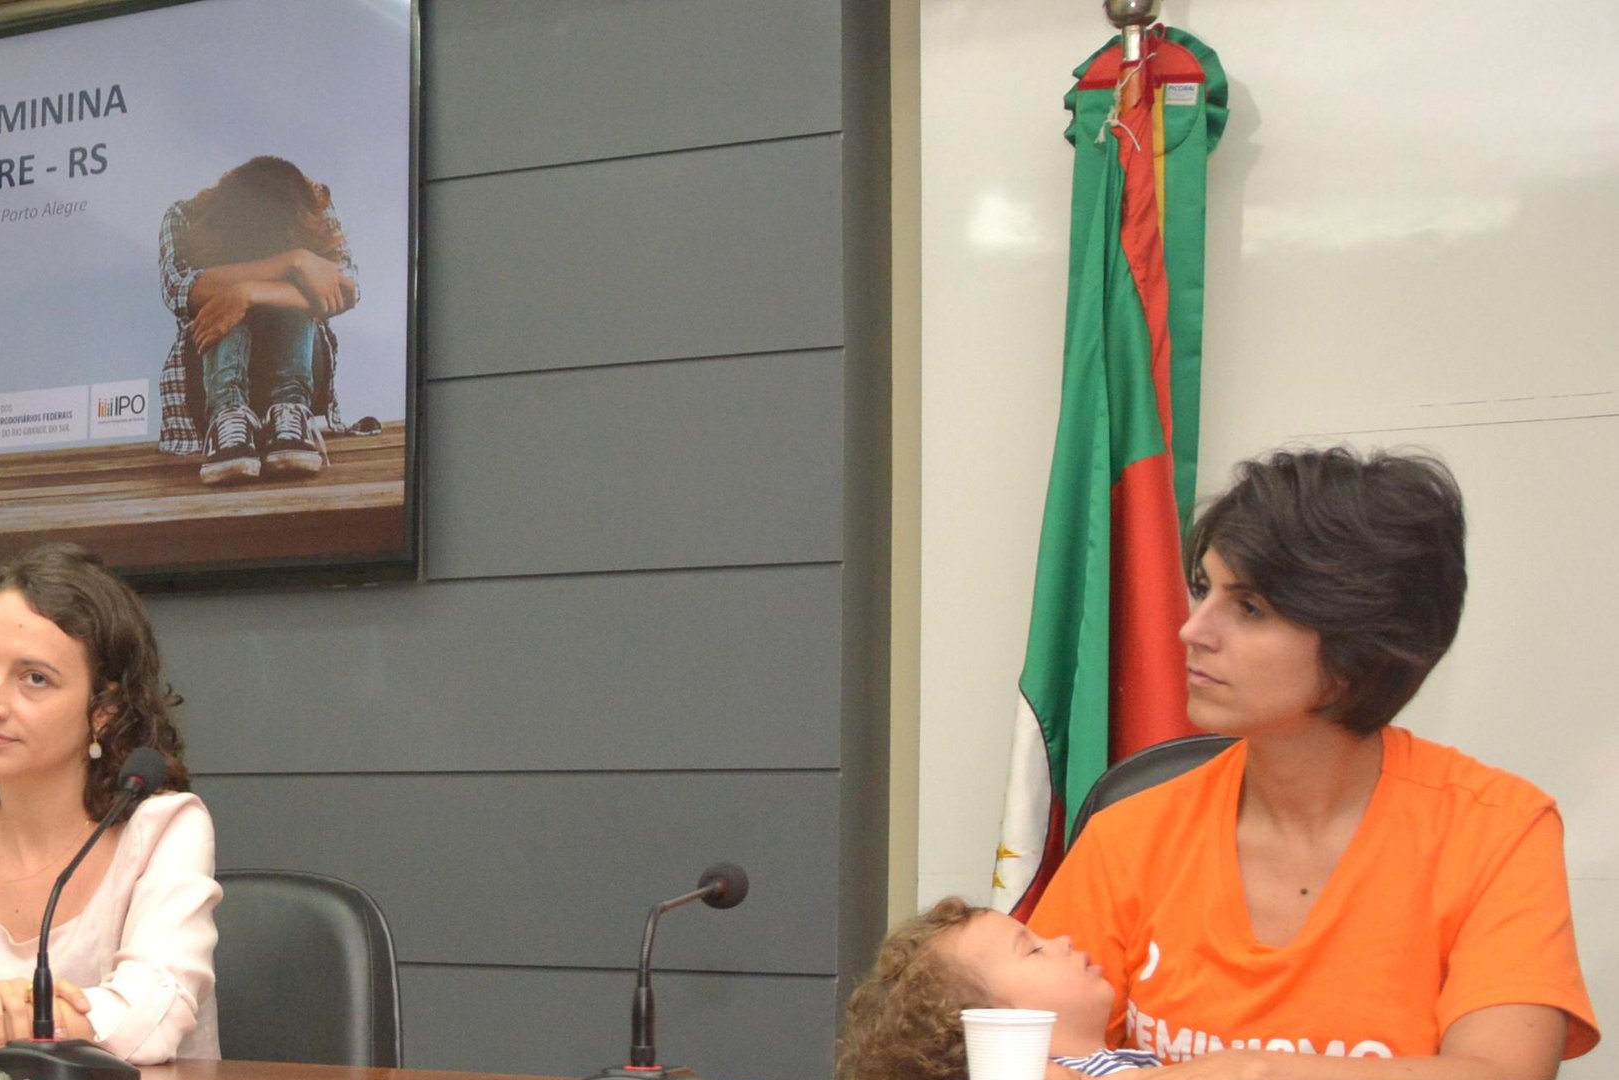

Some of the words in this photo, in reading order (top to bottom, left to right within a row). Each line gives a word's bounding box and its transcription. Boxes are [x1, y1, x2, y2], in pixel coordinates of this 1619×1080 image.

[68, 143, 108, 178] RS
[1, 205, 38, 223] Porto
[42, 199, 88, 218] Alegre
[42, 410, 73, 421] FEDERAIS
[114, 394, 146, 417] IPO
[1126, 998, 1394, 1064] FEMIO
